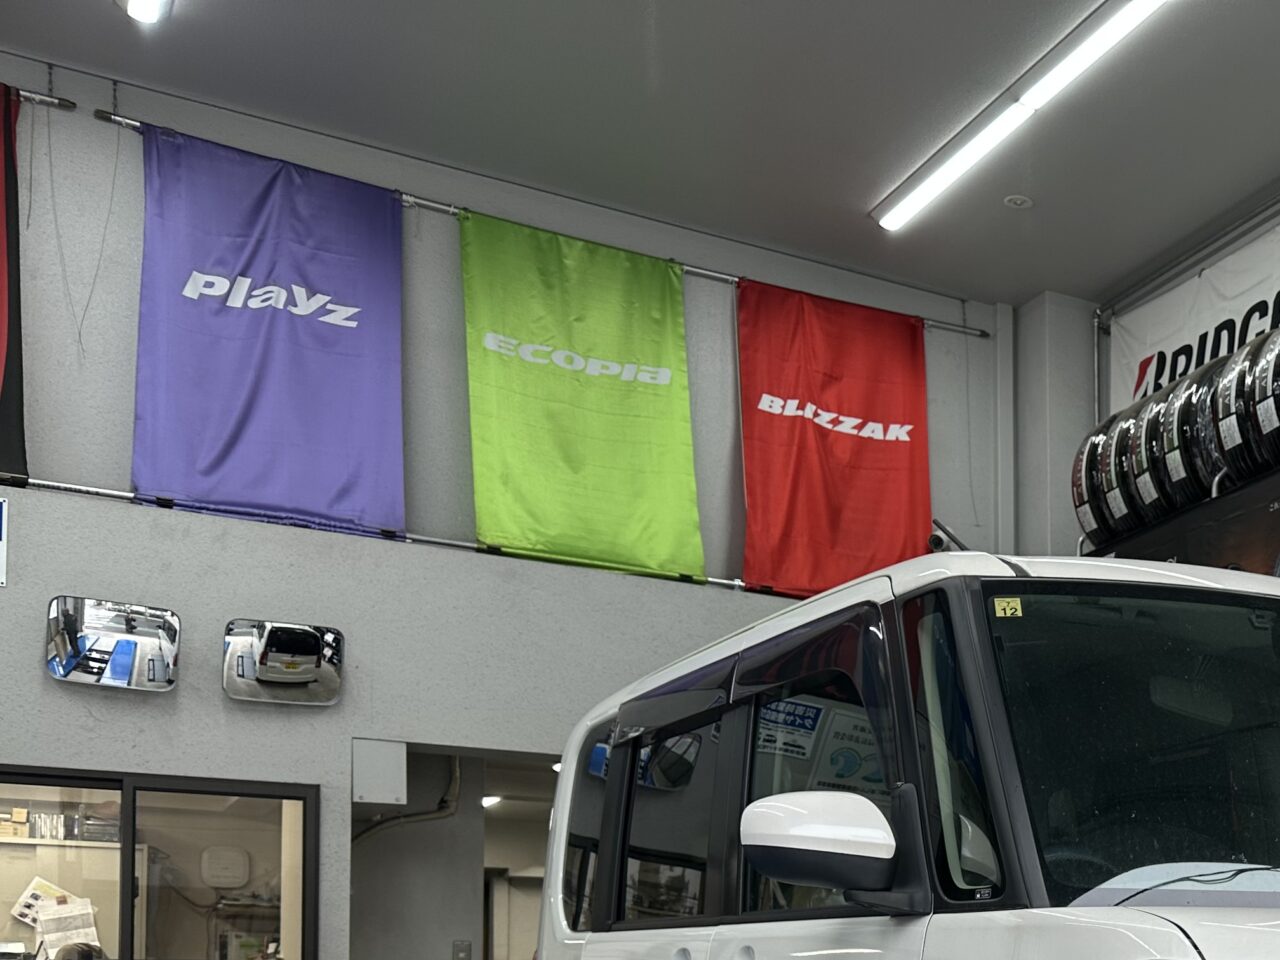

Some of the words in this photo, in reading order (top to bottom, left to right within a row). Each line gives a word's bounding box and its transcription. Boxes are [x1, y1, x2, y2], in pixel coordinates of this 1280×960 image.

[182, 271, 362, 328] Playz
[757, 393, 914, 441] BLIZZAK
[1001, 607, 1019, 616] 12
